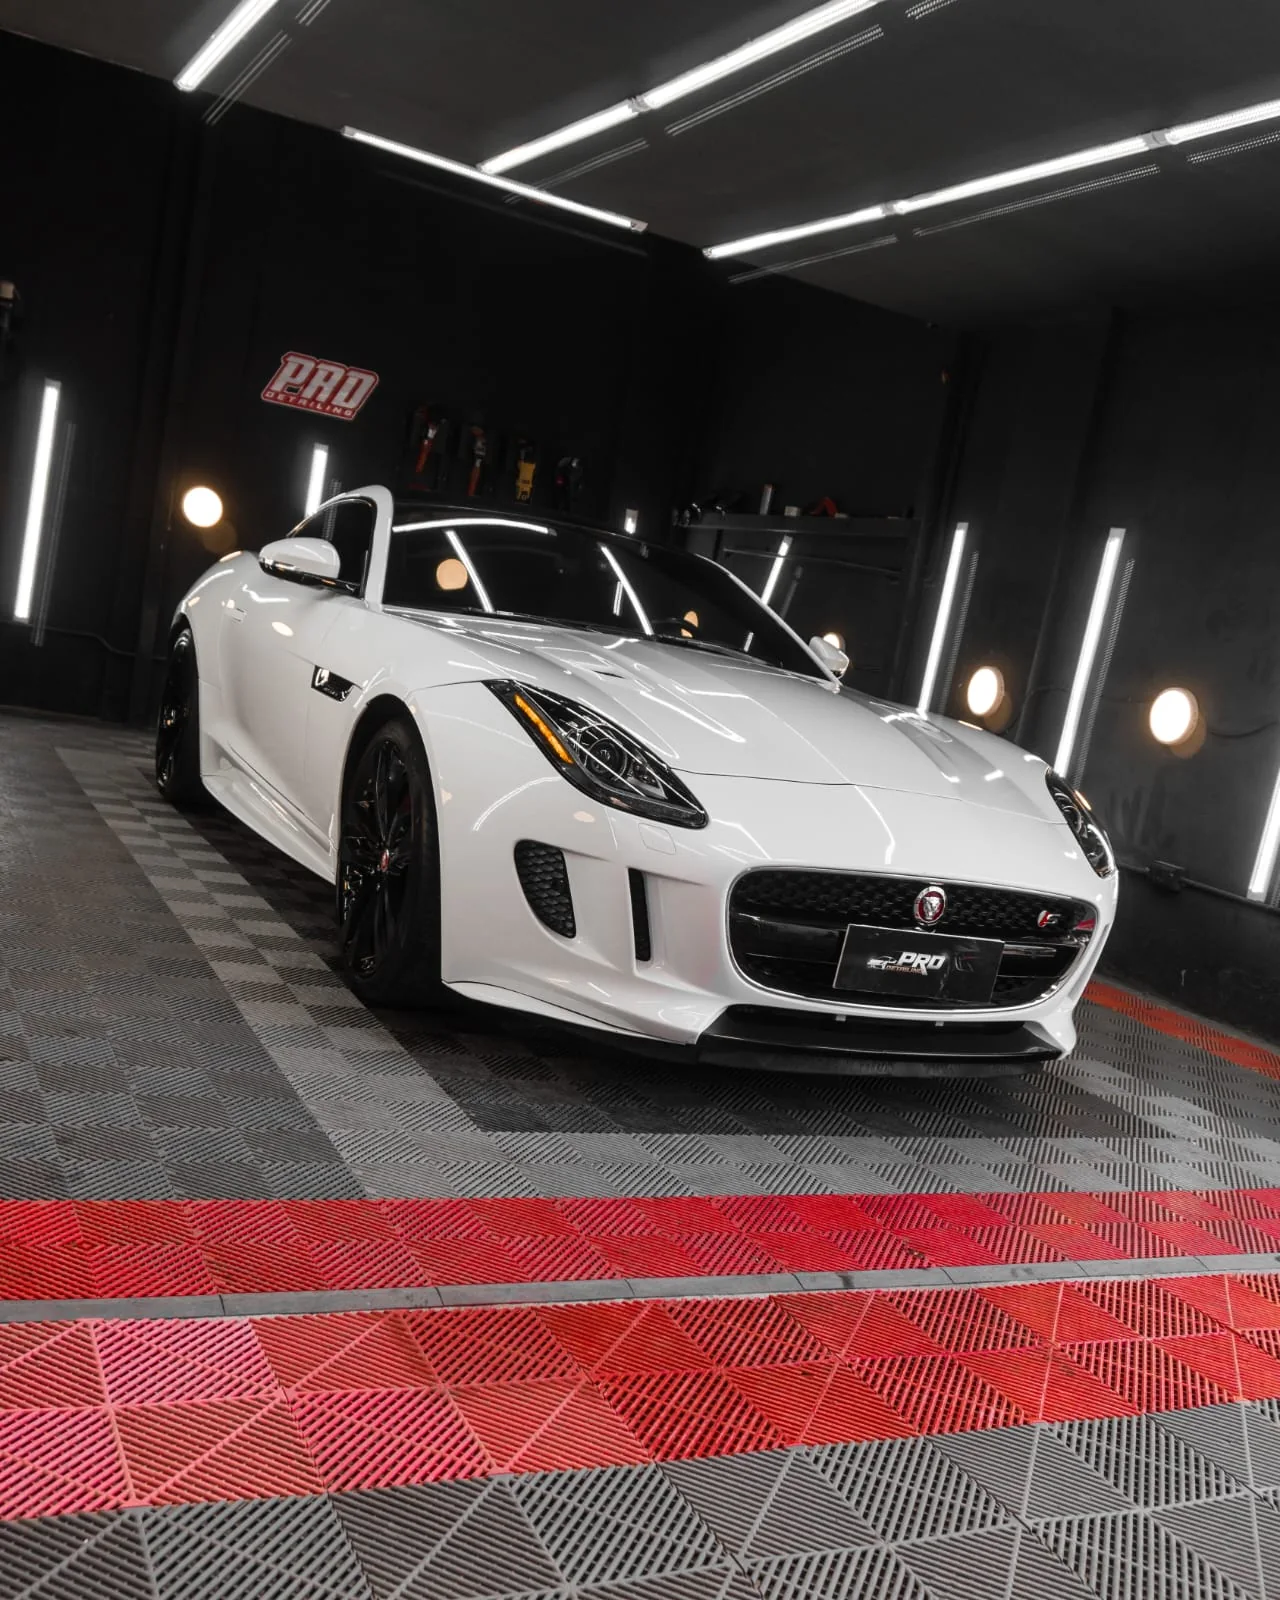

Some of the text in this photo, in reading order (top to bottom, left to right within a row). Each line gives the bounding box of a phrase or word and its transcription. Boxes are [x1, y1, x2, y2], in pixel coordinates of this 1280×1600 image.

[270, 355, 376, 409] PRO
[265, 391, 353, 416] DETAILING
[896, 951, 946, 976] PRO
